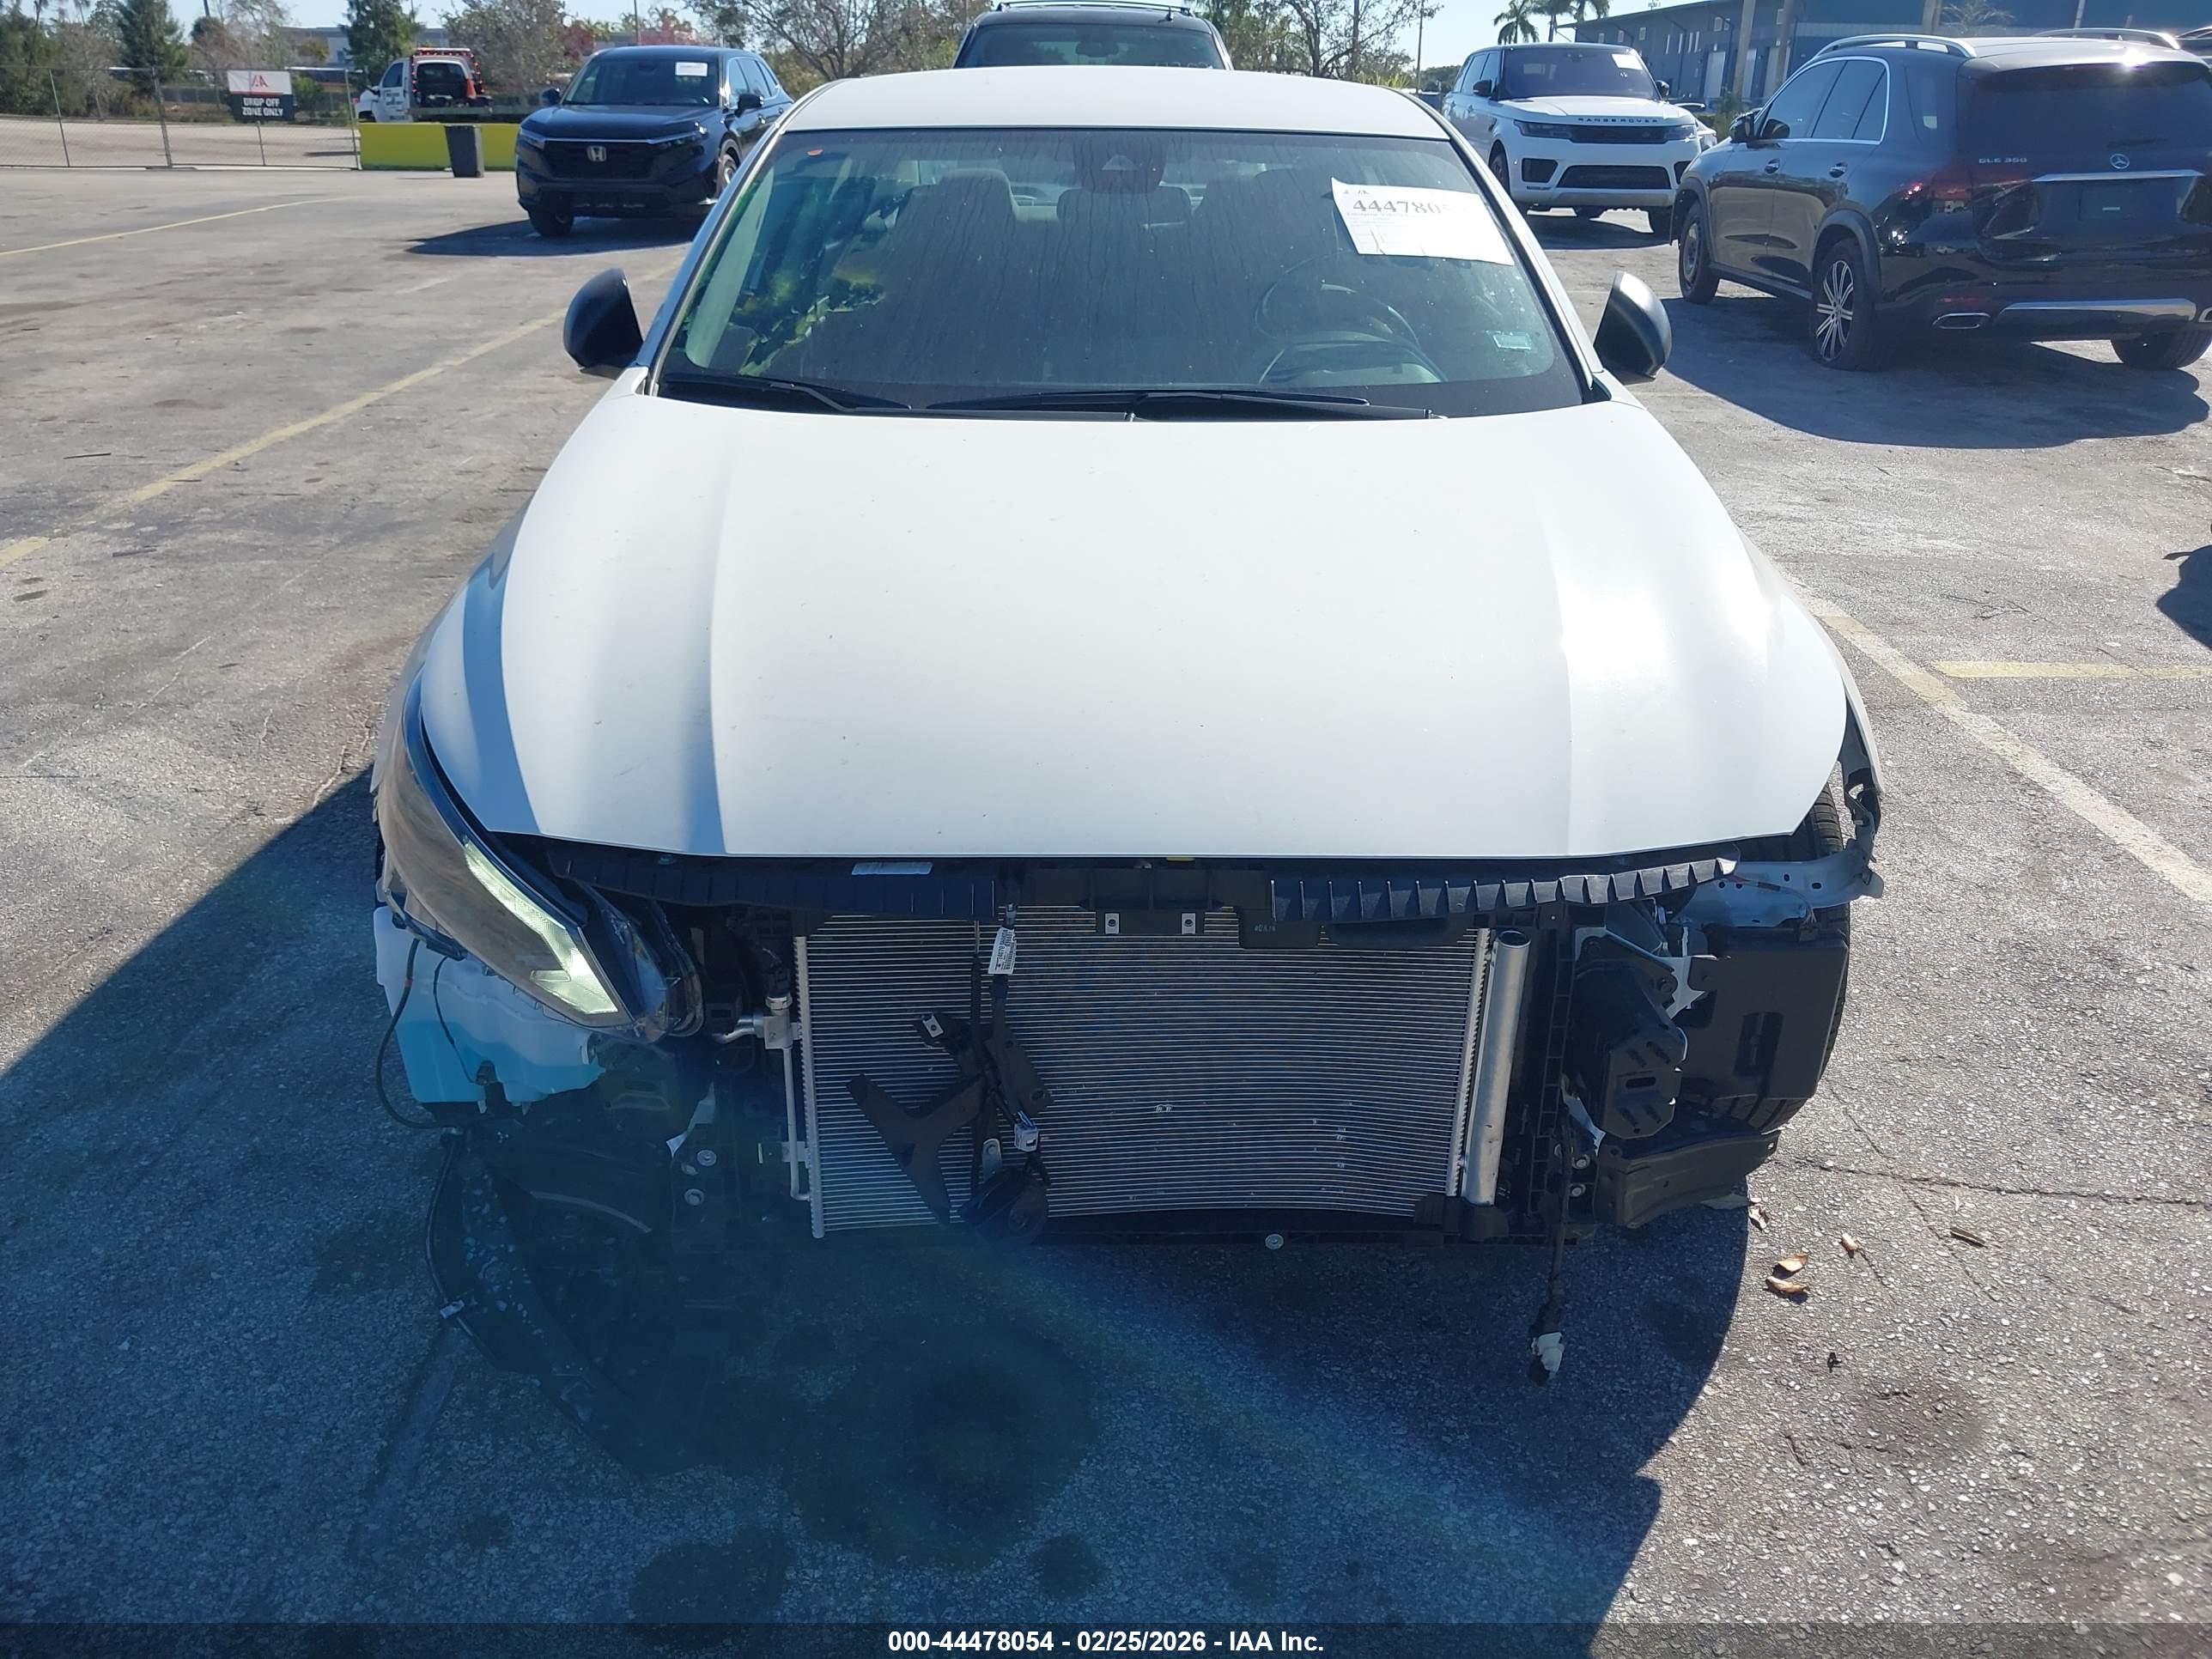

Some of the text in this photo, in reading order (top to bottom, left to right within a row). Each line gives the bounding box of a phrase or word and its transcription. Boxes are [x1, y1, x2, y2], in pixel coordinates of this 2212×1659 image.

[243, 97, 280, 107] DROP OFF
[241, 106, 283, 117] ZONE ONLY
